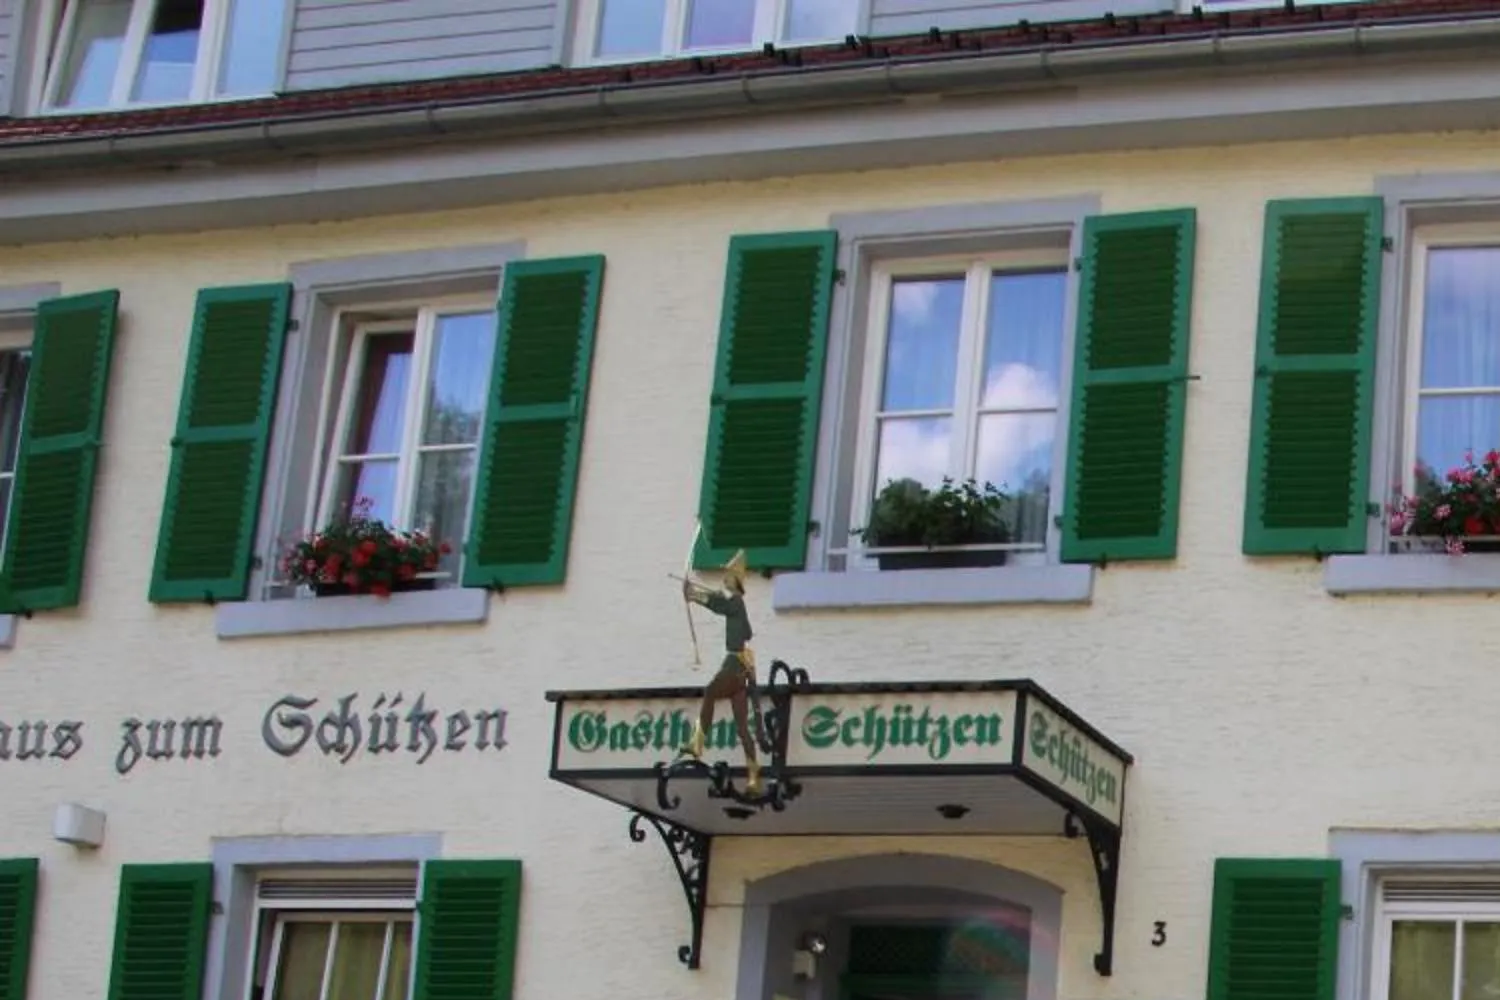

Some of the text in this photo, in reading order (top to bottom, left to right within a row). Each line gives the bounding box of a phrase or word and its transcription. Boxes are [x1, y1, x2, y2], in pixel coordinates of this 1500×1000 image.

[115, 714, 224, 775] zum
[262, 691, 510, 765] Schützen
[802, 704, 1003, 760] Schützen
[1029, 711, 1116, 806] Schützen
[1151, 921, 1167, 947] 3
